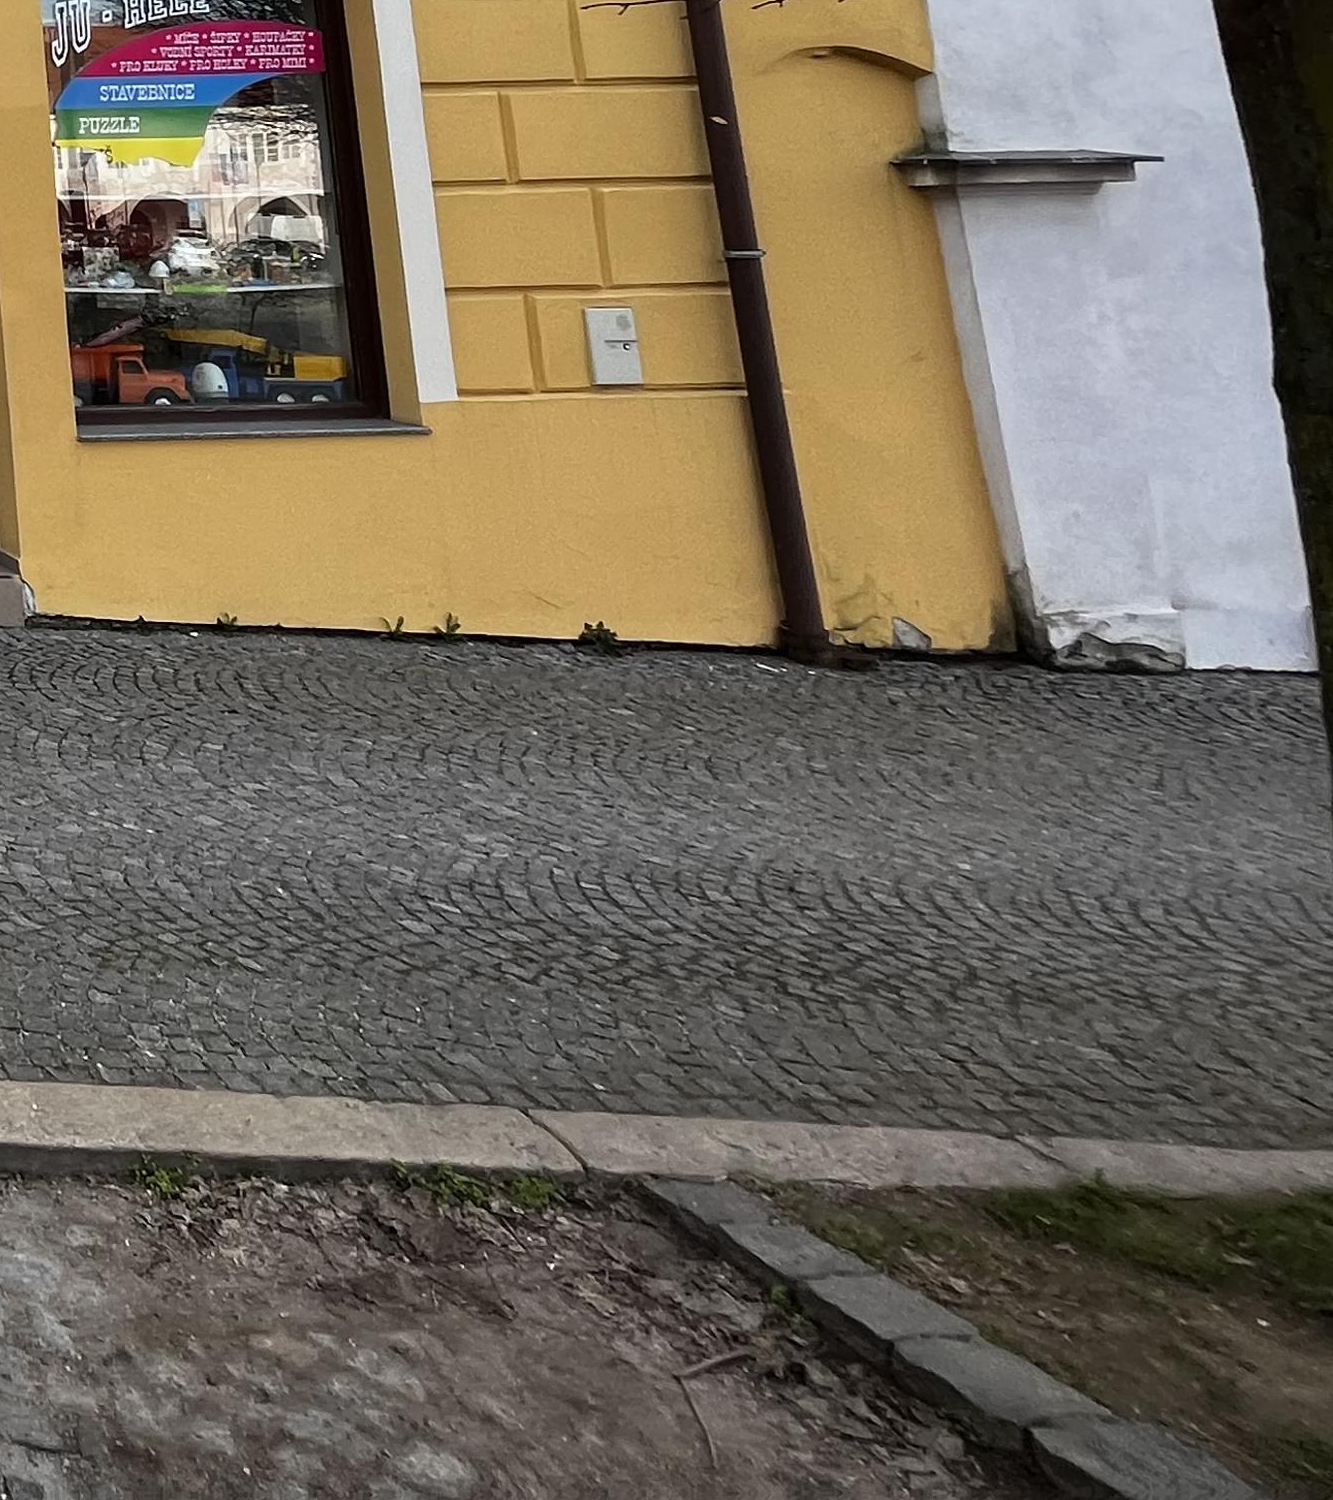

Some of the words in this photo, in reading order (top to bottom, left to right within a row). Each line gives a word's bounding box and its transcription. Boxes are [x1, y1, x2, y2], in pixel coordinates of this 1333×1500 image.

[119, 61, 141, 72] PRO
[189, 59, 211, 71] PRO
[258, 58, 280, 69] PRO
[99, 83, 195, 102] STAVEBNICE
[78, 116, 140, 135] PUZZLE
